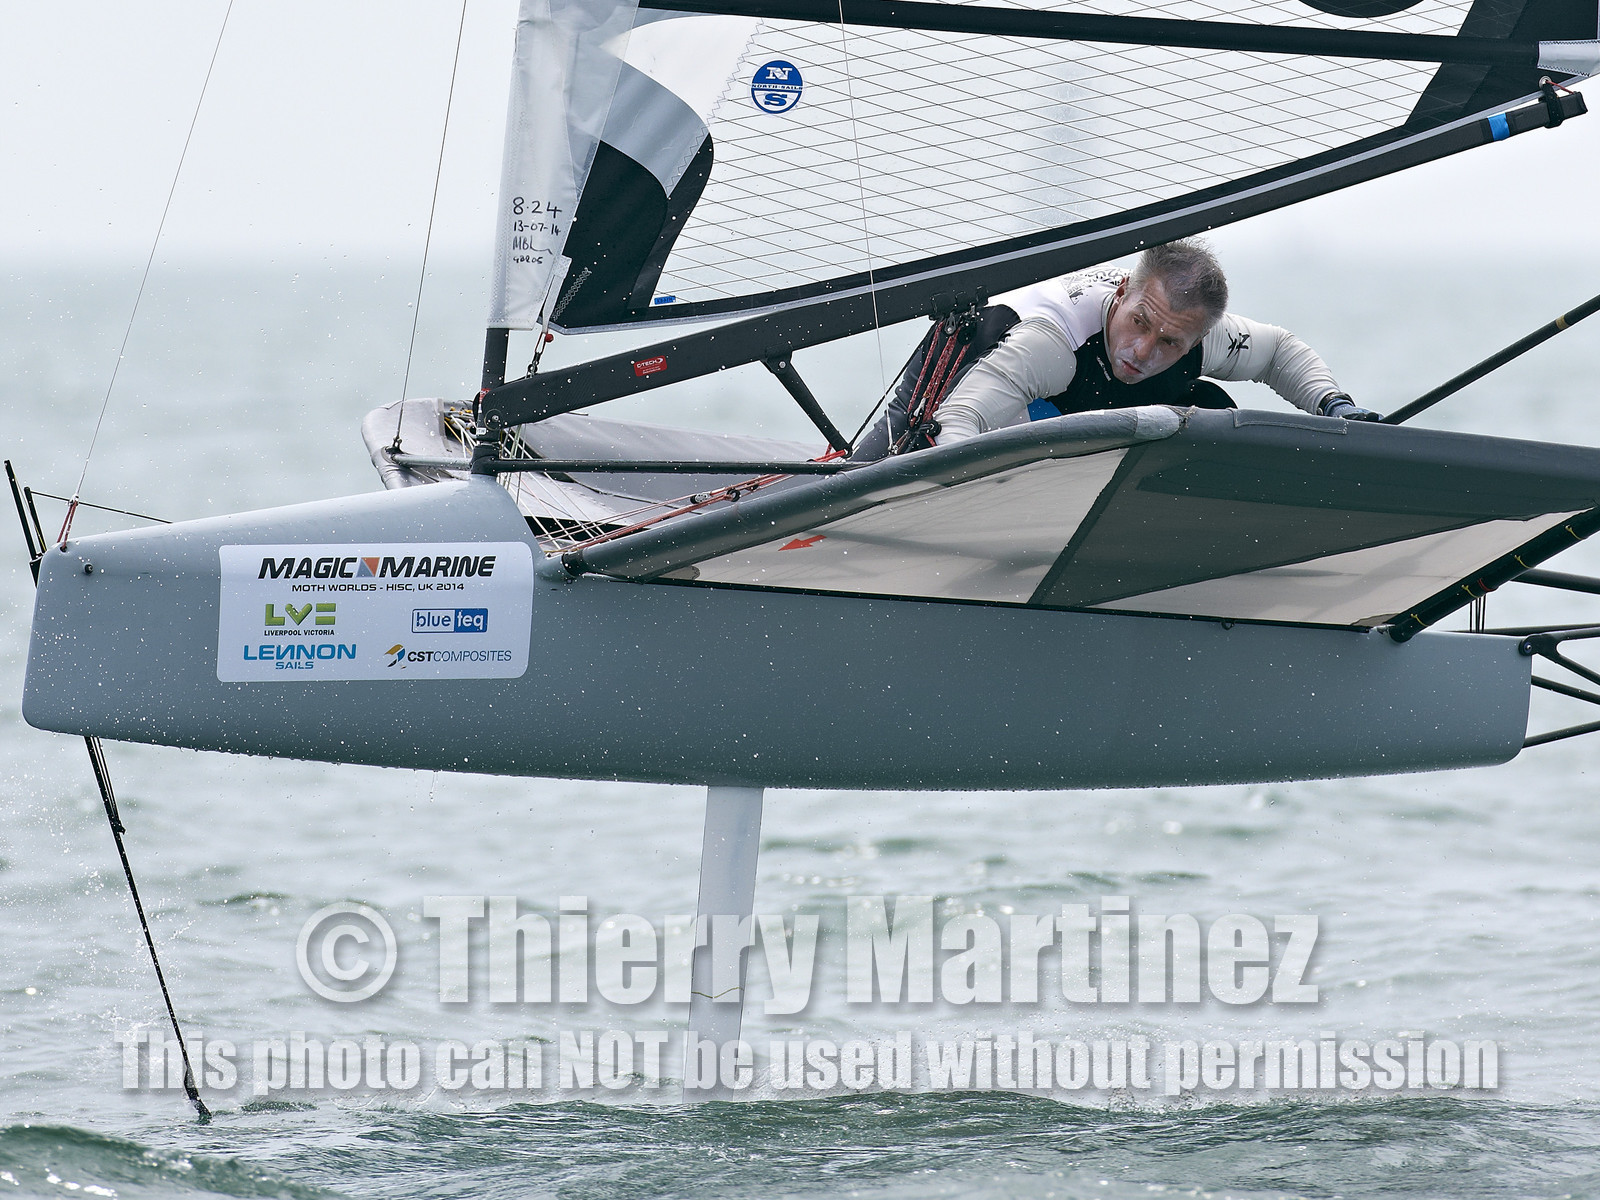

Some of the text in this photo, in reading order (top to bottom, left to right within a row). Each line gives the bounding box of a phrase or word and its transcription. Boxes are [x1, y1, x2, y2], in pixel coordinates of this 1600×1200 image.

[765, 66, 793, 81] N
[764, 93, 788, 107] S
[513, 219, 561, 236] 13-07-14
[258, 555, 496, 579] MAGIC MARINE
[328, 583, 377, 591] WORLDS
[386, 583, 415, 592] HISC,
[275, 661, 314, 669] SAILS
